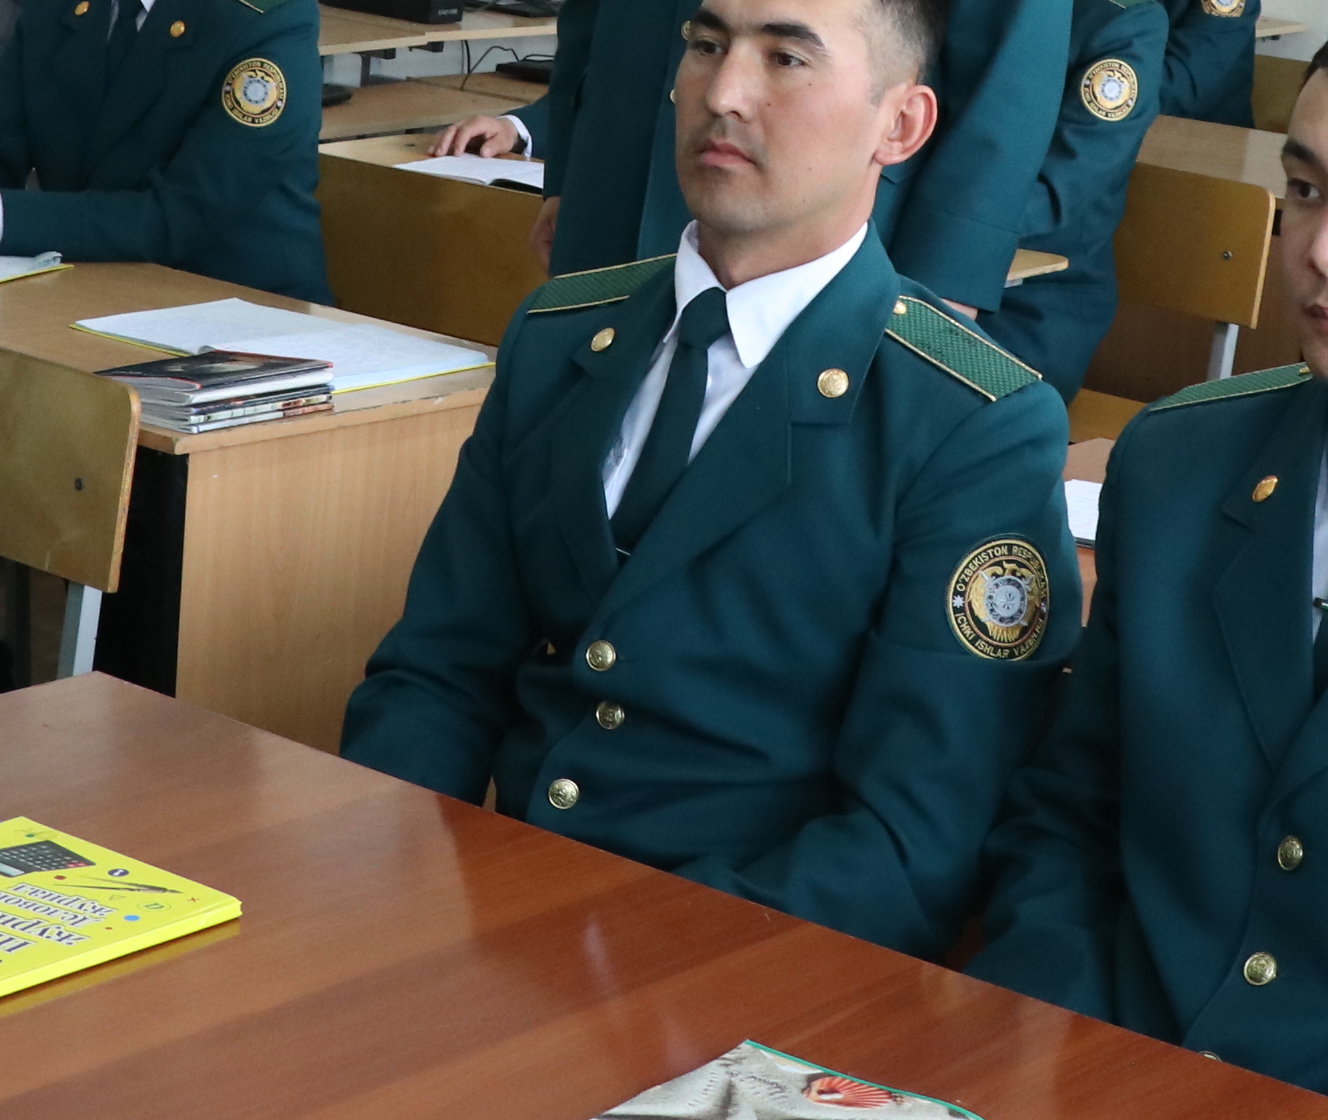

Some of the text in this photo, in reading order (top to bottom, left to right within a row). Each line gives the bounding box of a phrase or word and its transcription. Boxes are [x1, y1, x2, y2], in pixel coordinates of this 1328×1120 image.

[956, 546, 1008, 591] O'ZBEKISTON
[955, 613, 976, 640] ICHKI
[975, 639, 1010, 658] ISHLAR
